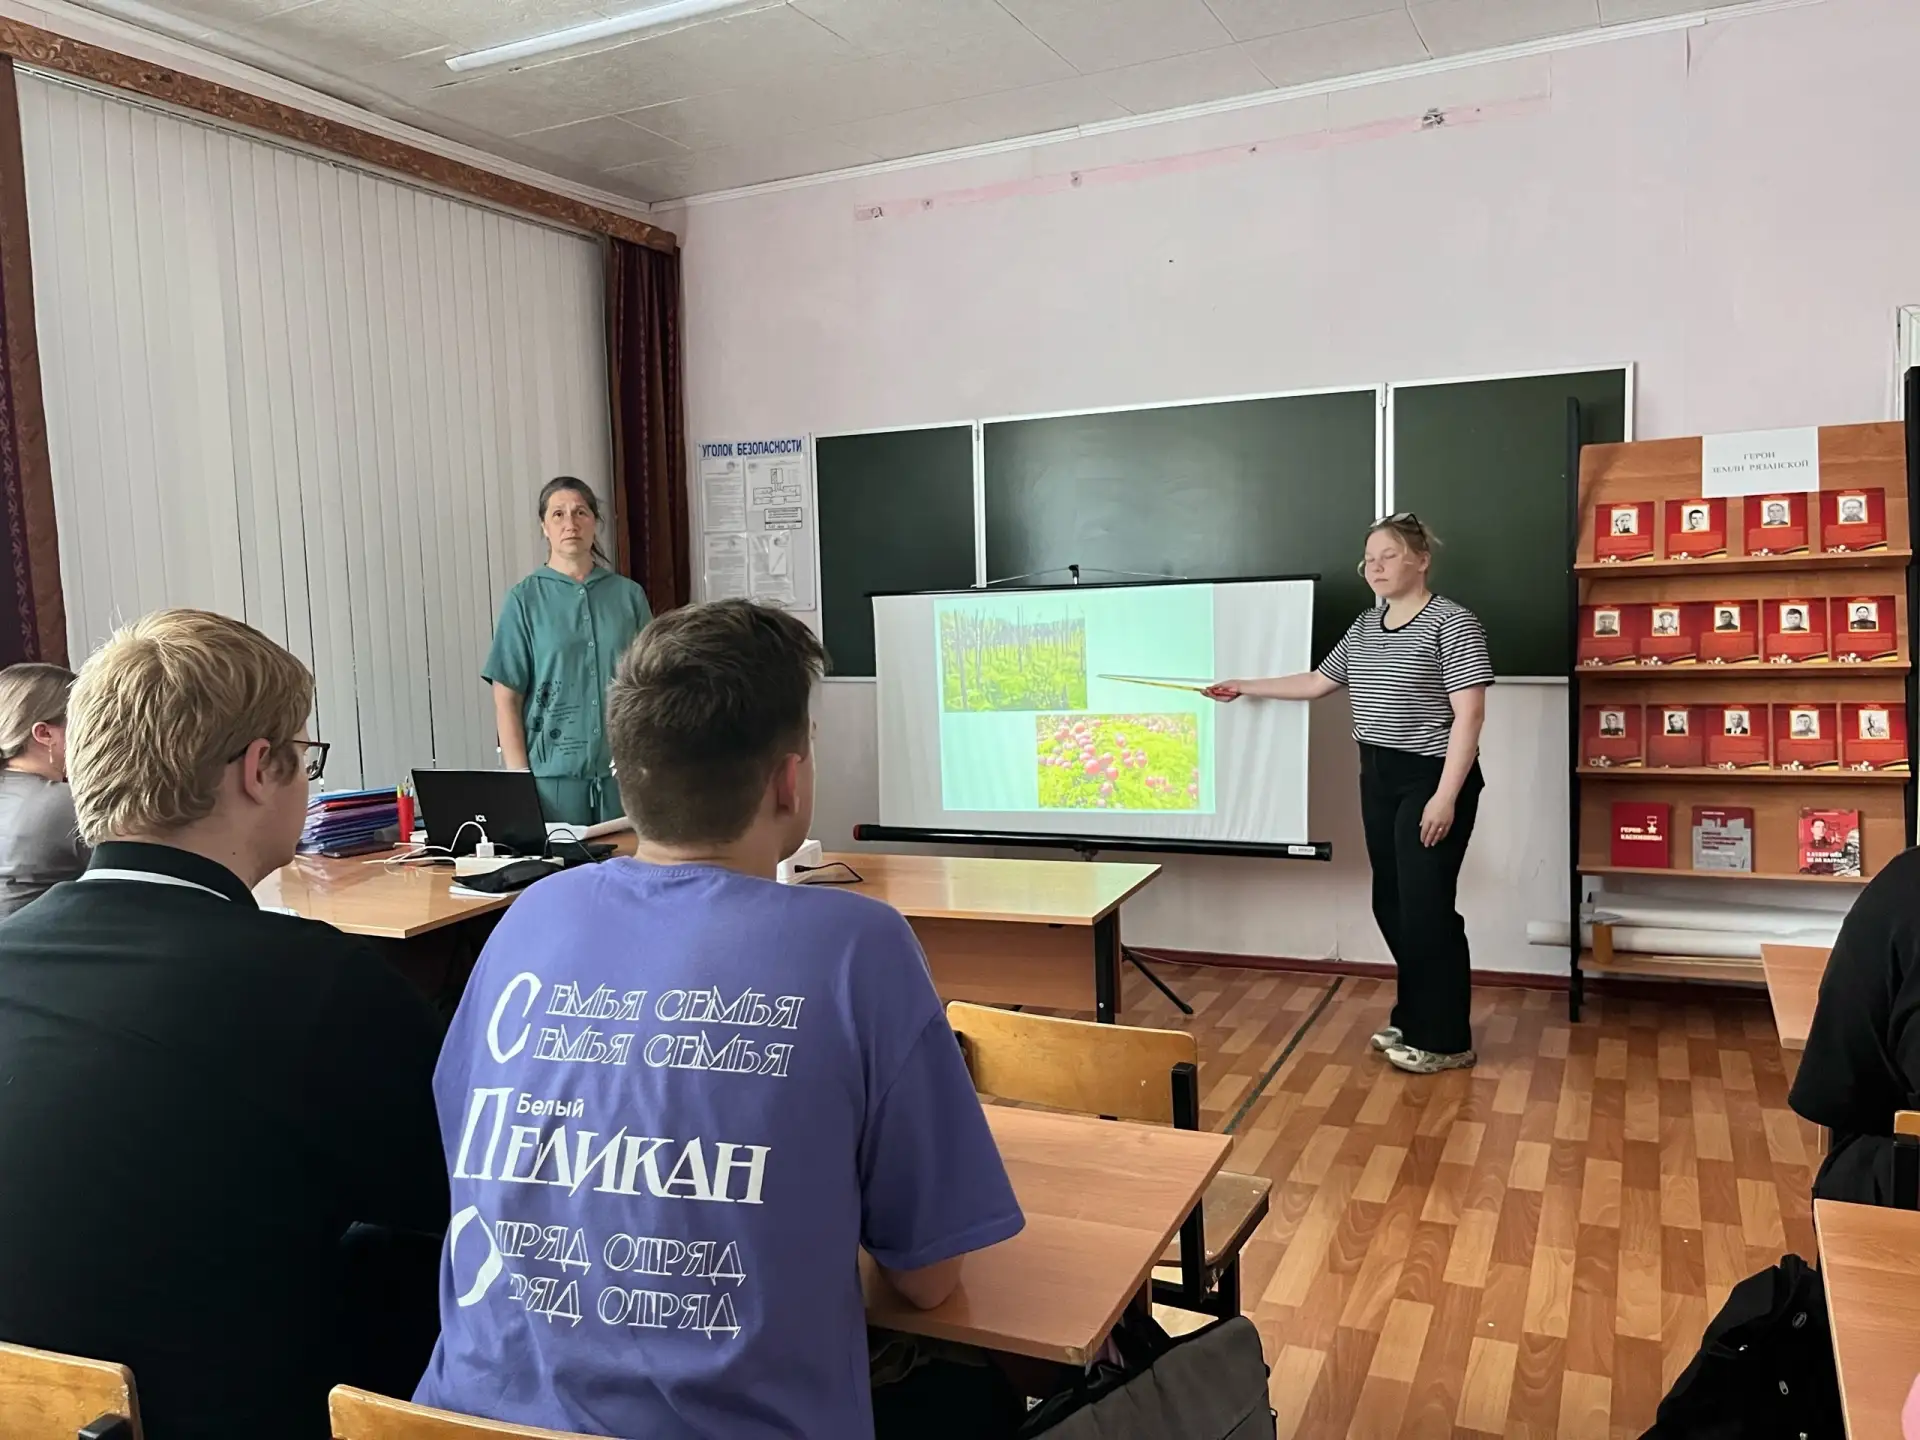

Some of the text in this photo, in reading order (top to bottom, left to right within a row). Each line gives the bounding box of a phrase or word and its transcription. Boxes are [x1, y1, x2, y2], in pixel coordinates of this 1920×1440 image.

[702, 439, 802, 457] УГОЛОК БЕЗОПАСНОСТИ
[1712, 459, 1809, 474] ЗЕМЛИ РЯЗАНСКОЙ
[1743, 451, 1775, 460] ГЕРОИ
[655, 985, 805, 1030] СЕМЬЯ
[643, 1030, 794, 1077] СЕМЬЯ
[516, 1092, 584, 1118] Белый
[453, 1087, 771, 1204] ПЕЛИКАН
[603, 1233, 746, 1287] ОТРЯД
[597, 1285, 741, 1340] ОТРЯД
